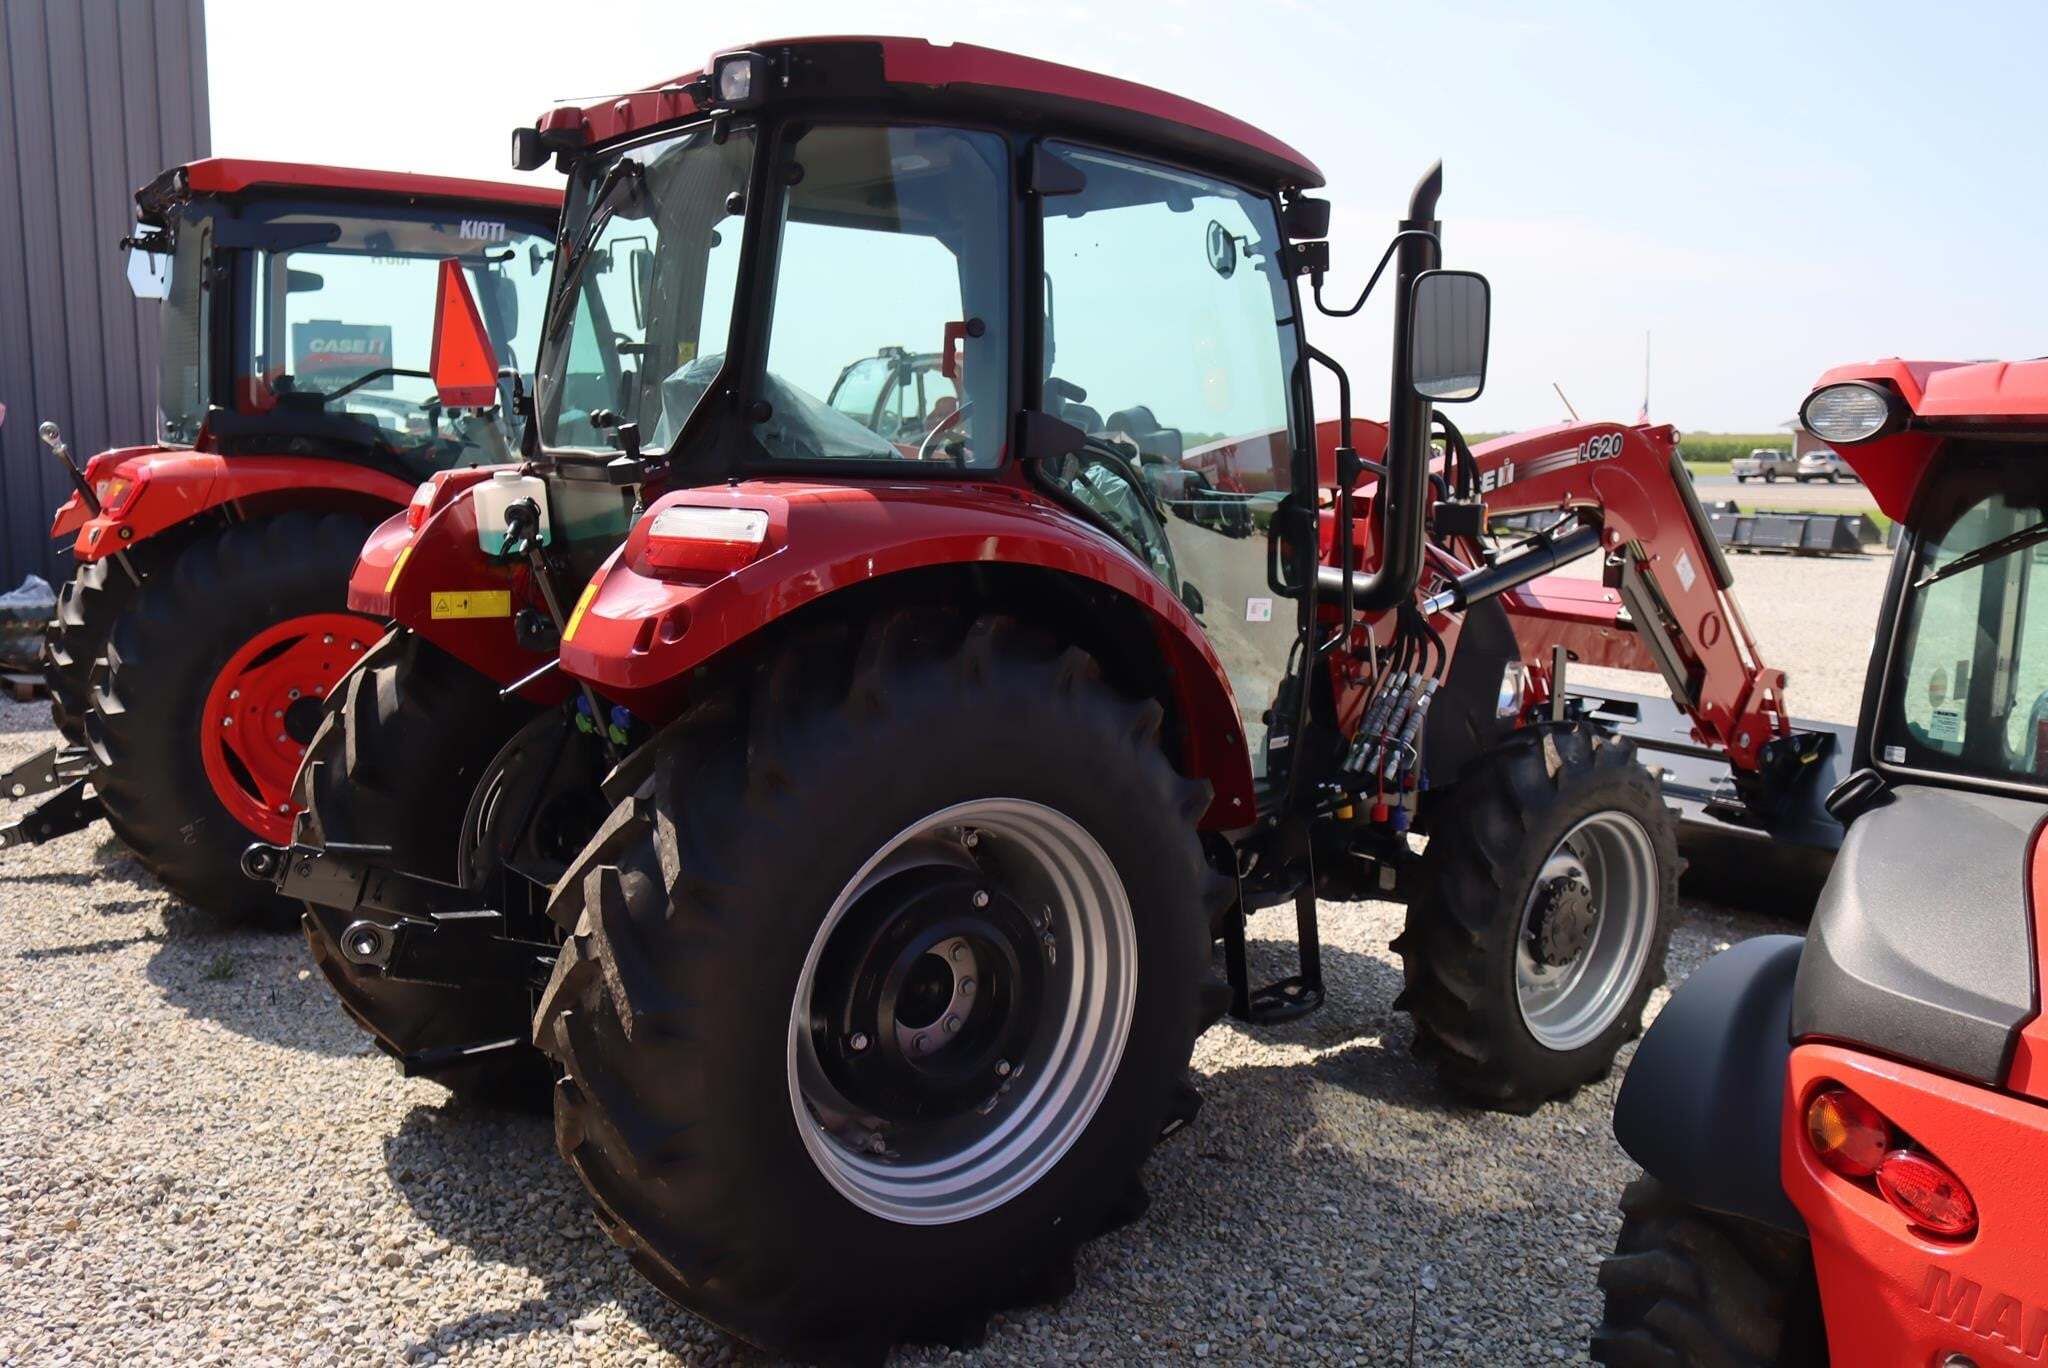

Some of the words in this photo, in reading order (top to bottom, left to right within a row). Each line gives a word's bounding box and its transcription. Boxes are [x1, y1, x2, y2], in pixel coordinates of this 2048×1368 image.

[460, 219, 505, 241] KIOTI
[308, 338, 366, 353] CASE
[1578, 432, 1623, 464] L620
